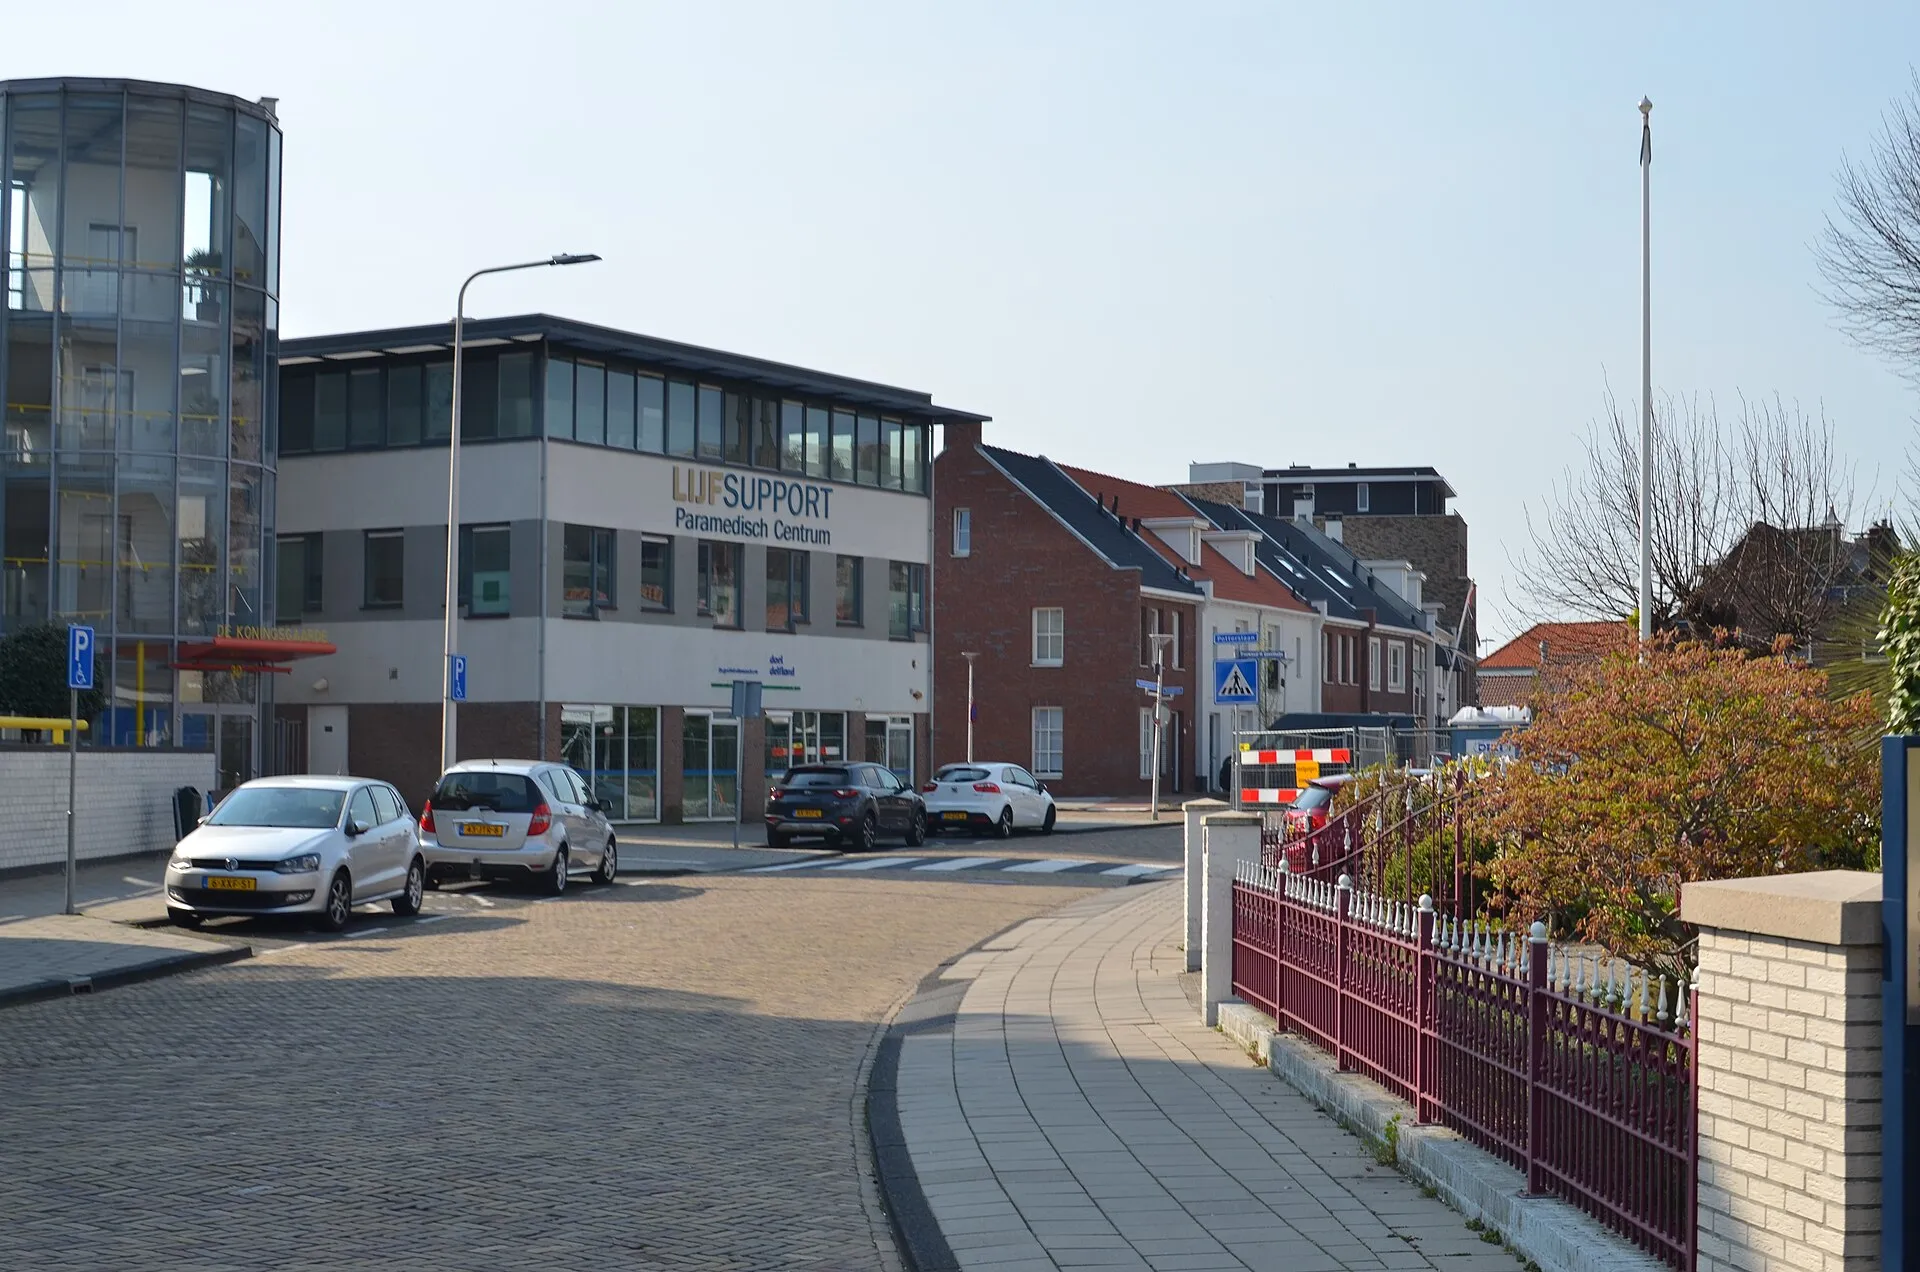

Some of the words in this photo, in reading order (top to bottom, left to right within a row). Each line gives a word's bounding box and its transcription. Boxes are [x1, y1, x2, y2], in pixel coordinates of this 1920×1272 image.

[673, 465, 834, 519] LIJFSUPPORT
[675, 507, 768, 538] Paramedisch
[774, 519, 831, 545] Centrum
[75, 630, 89, 661] P
[216, 624, 232, 639] DE
[236, 624, 329, 643] KONINGSGAARDE
[456, 658, 464, 681] P
[1478, 743, 1503, 752] DII
